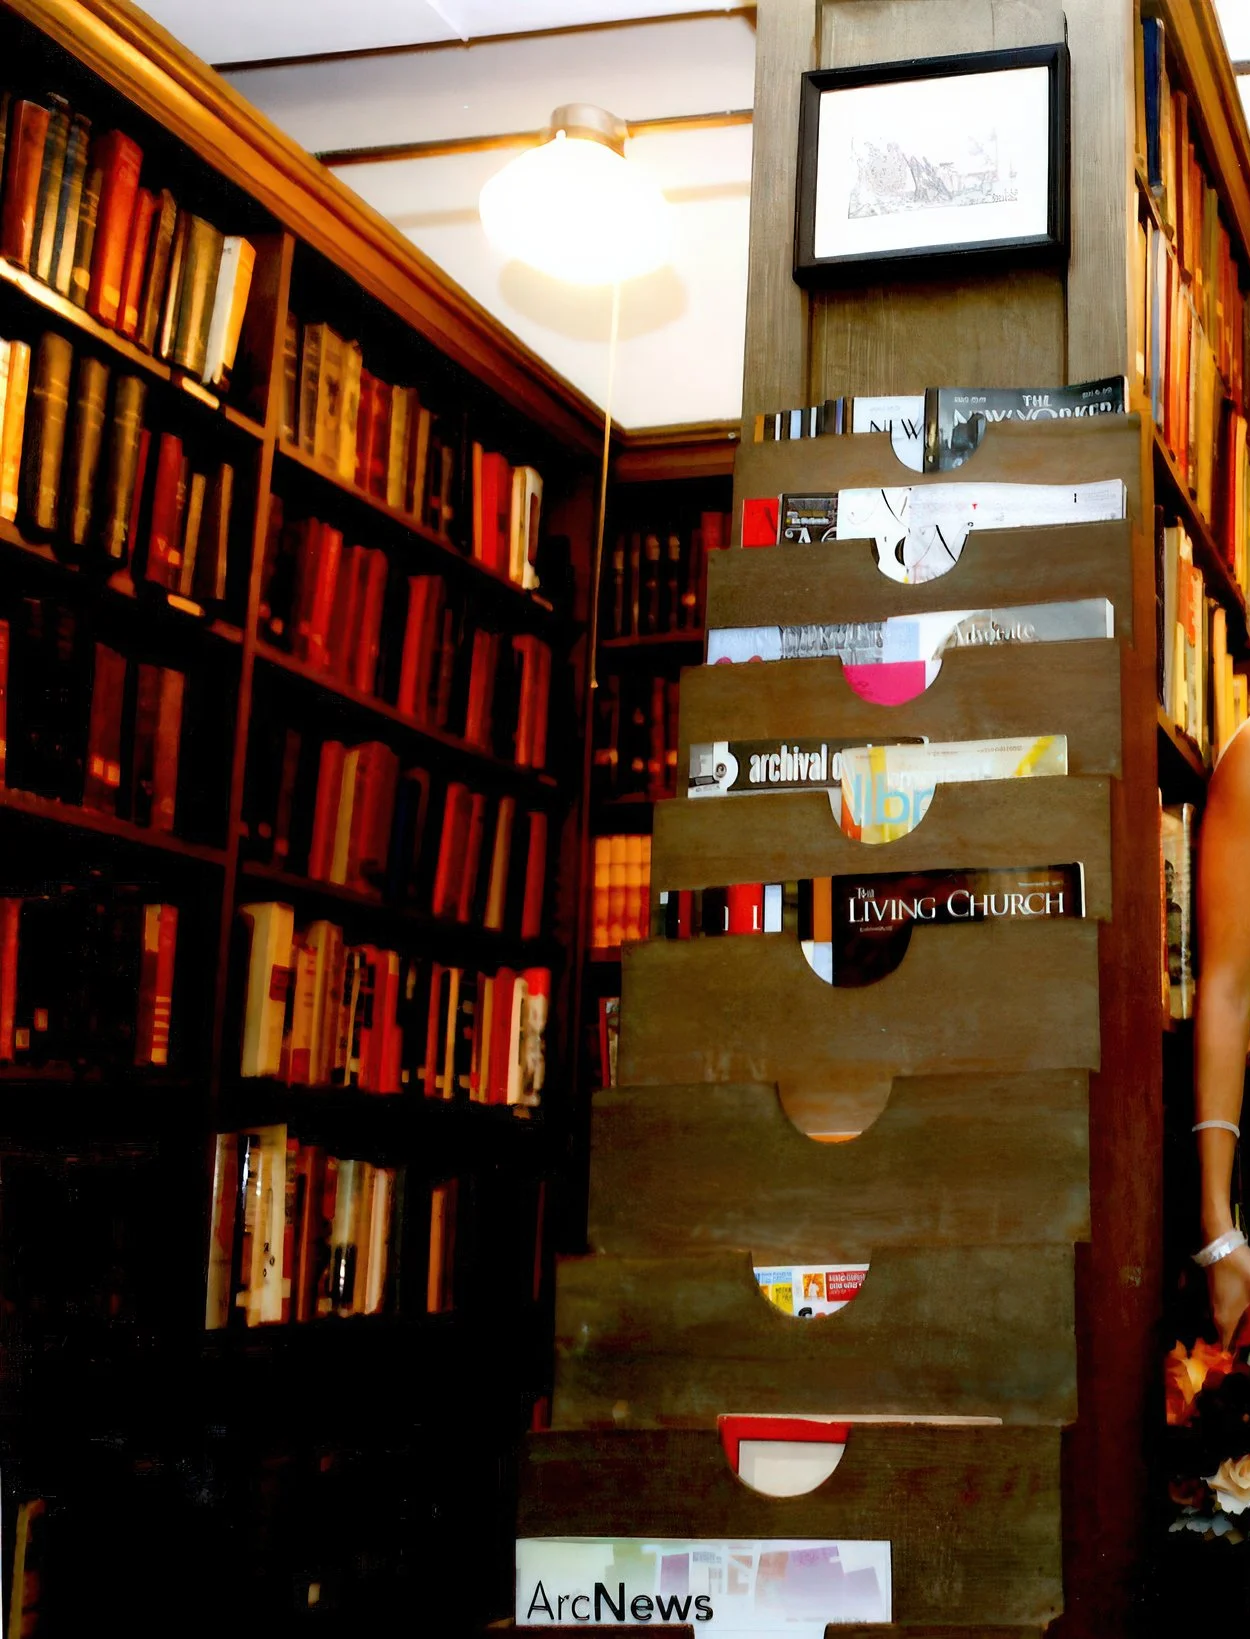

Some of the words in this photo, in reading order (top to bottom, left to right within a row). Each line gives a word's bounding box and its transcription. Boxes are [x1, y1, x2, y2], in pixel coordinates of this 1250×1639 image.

[953, 408, 1012, 427] NW
[749, 743, 828, 783] archival
[849, 896, 936, 923] LIVING
[947, 889, 1065, 918] CHURCH
[526, 1579, 714, 1622] ArcNews
